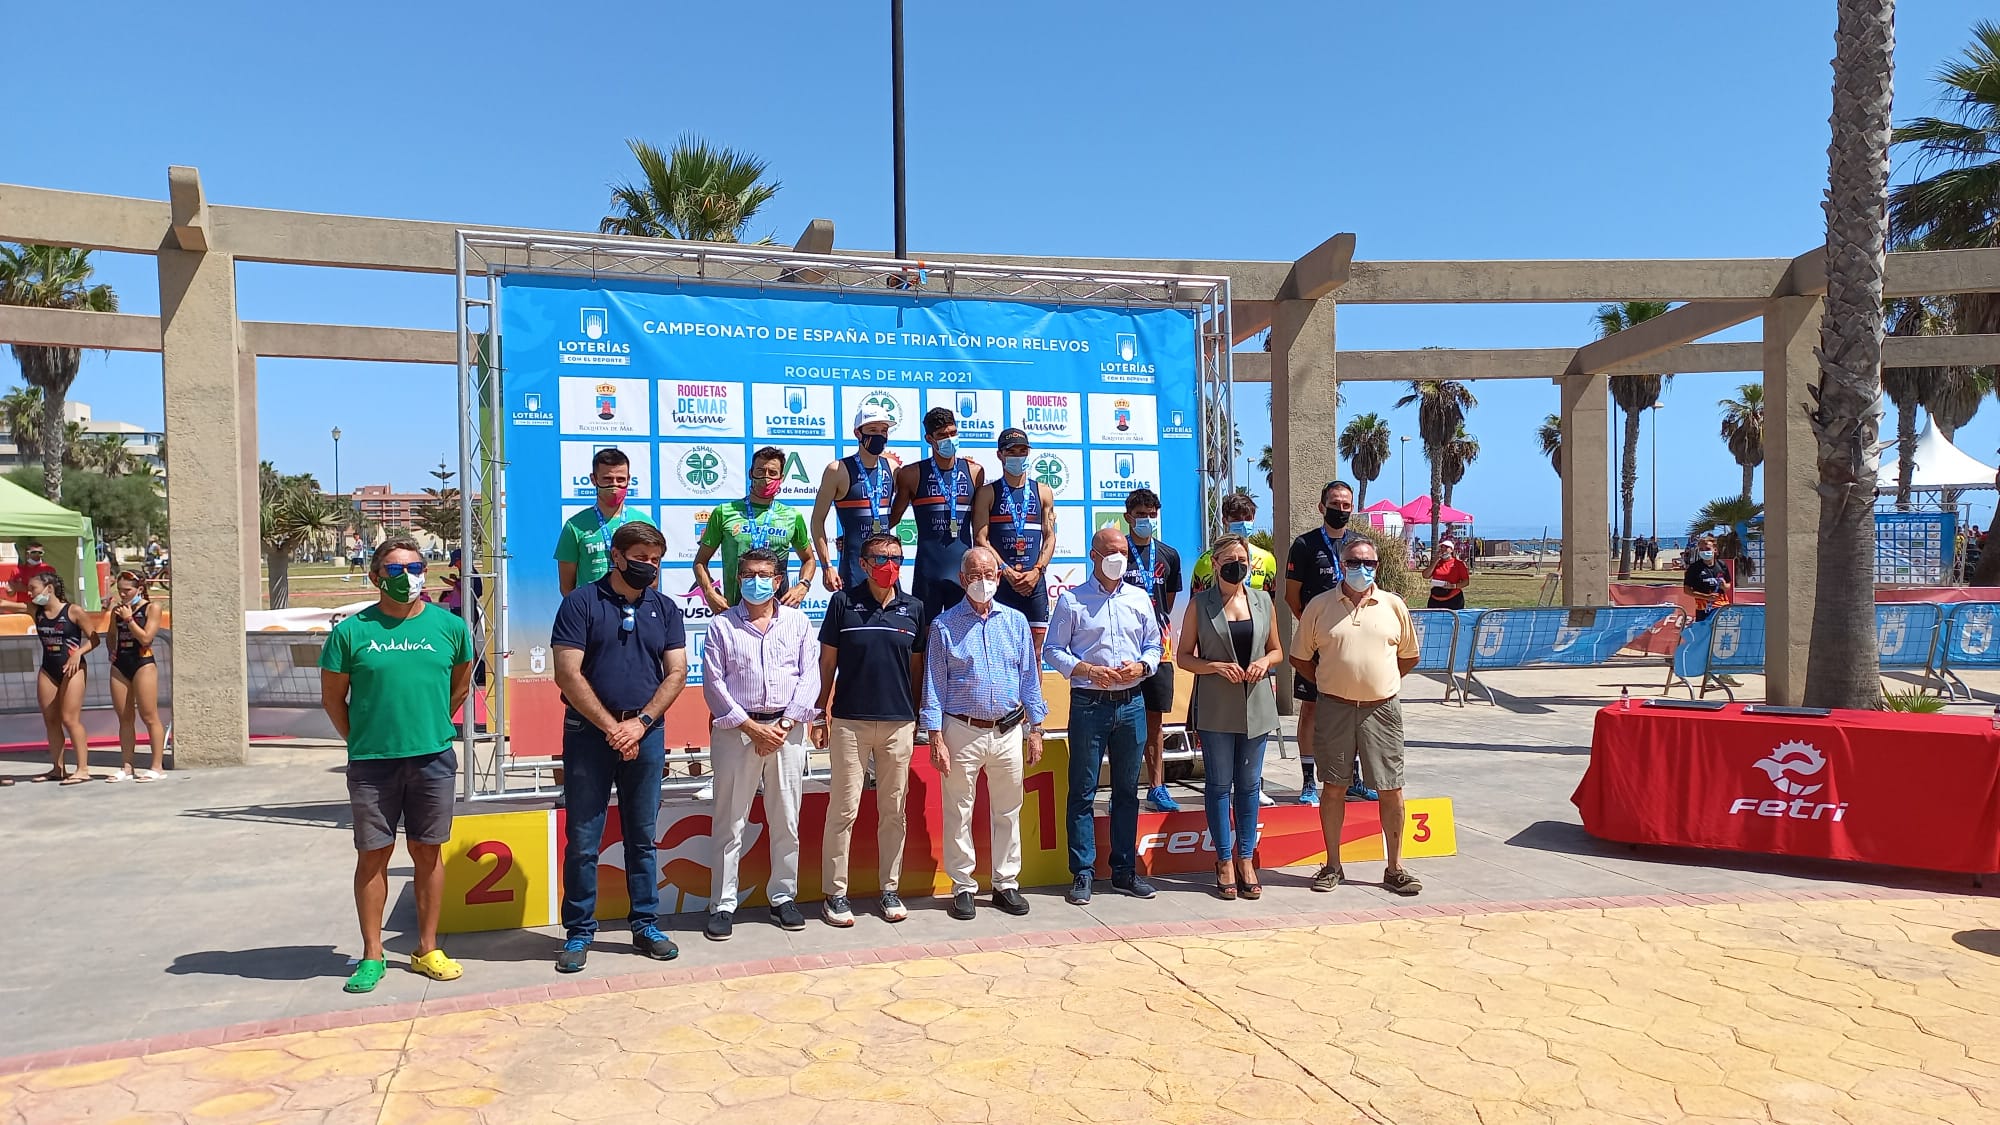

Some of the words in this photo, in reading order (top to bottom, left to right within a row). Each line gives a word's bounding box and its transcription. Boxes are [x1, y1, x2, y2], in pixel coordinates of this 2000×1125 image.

[643, 320, 769, 341] CAMPEONATO
[775, 327, 798, 342] DE
[803, 327, 870, 345] ESPAÑA
[875, 332, 897, 346] DE
[901, 333, 982, 348] TRIATLÓN
[986, 335, 1019, 350] POR
[1022, 337, 1090, 353] RELEVOS
[558, 340, 631, 354] LOTERÍAS
[784, 366, 871, 381] ROQUETAS
[876, 369, 897, 382] DE
[901, 370, 934, 383] MAR
[938, 371, 972, 383] 2021
[1100, 362, 1156, 374] LOTERÍAS
[677, 384, 728, 398] ROQUETAS
[678, 398, 695, 414] DE
[696, 399, 728, 415] MAR
[1026, 394, 1068, 408] ROQUETAS
[512, 411, 554, 420] LOTERÍAS
[672, 409, 726, 425] turismo
[765, 415, 826, 426] LOTERÍAS
[955, 418, 995, 430] TERÍAS
[1099, 478, 1151, 489] LOTERÍAS
[366, 637, 438, 654] Andalucía
[1023, 770, 1058, 851] 1
[1728, 797, 1849, 823] Fetri
[1411, 813, 1431, 843] 3
[464, 840, 515, 905] 2
